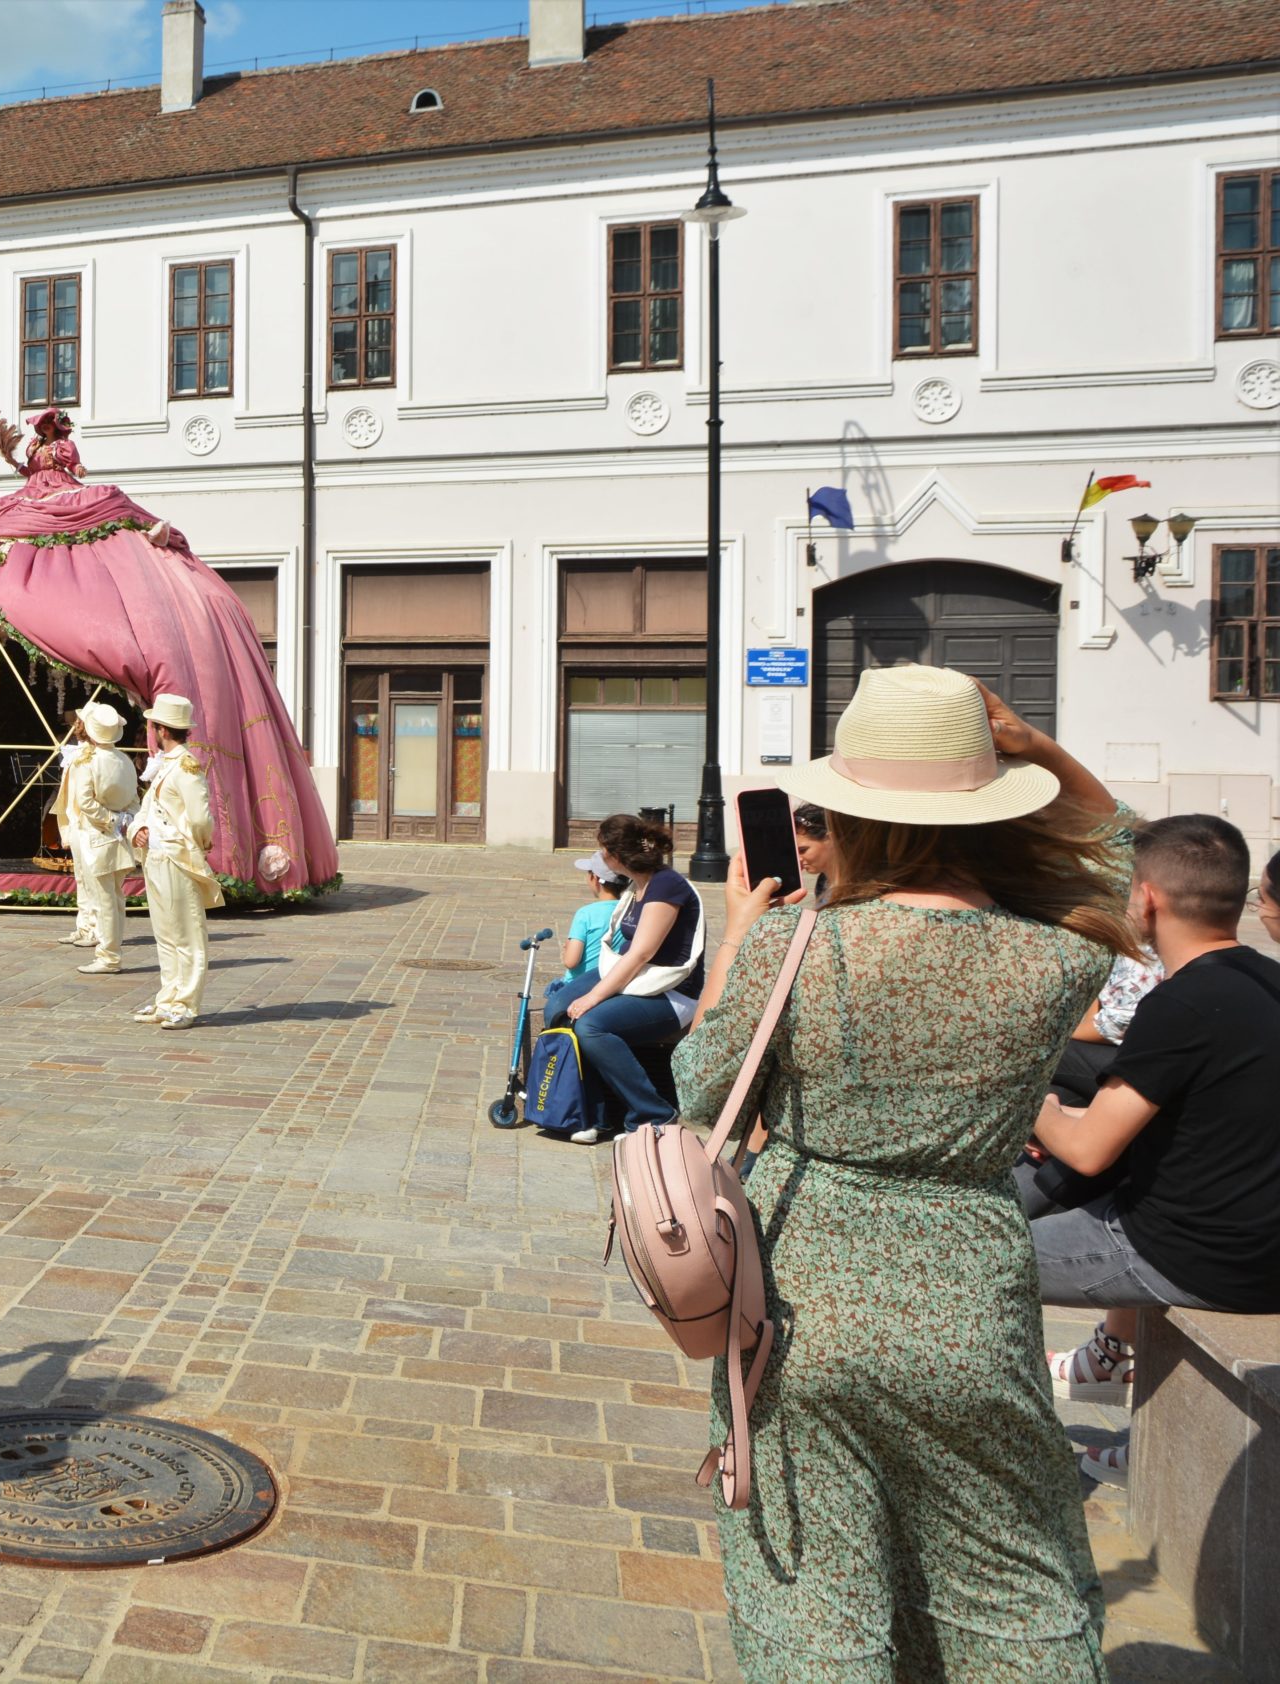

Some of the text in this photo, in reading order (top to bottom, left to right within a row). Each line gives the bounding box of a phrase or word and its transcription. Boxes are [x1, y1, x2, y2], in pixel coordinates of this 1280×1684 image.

[537, 1055, 558, 1112] SKECHERS
[127, 1442, 190, 1477] ORADEA
[60, 1513, 154, 1530] ORADEA
